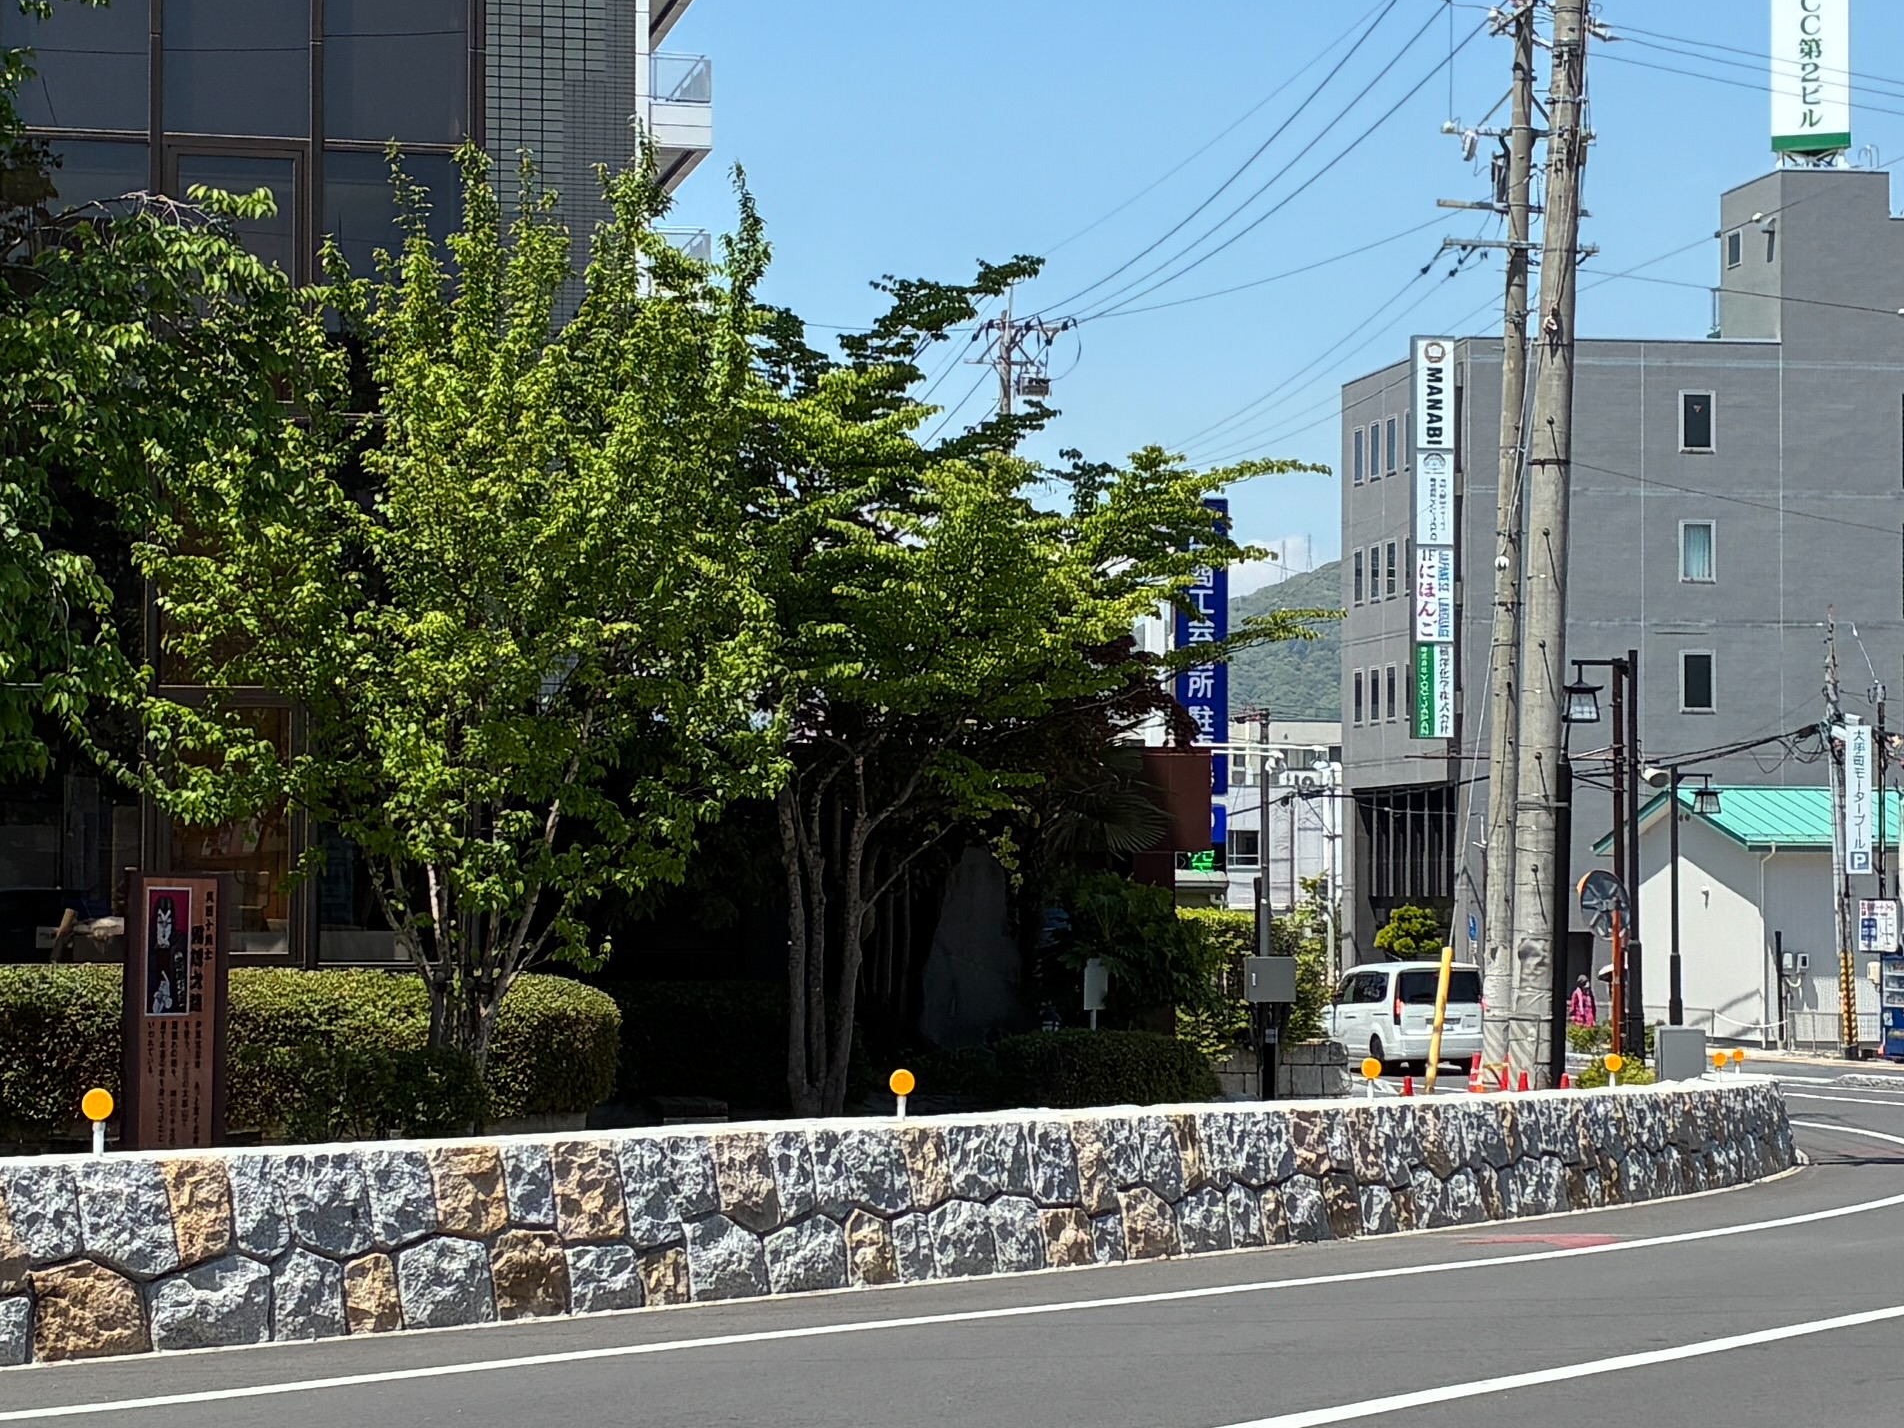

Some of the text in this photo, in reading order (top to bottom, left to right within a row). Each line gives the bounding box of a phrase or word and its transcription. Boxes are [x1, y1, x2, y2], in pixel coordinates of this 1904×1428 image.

[1426, 367, 1443, 445] MANABI
[1418, 564, 1437, 637] にほんご
[1853, 854, 1866, 869] P
